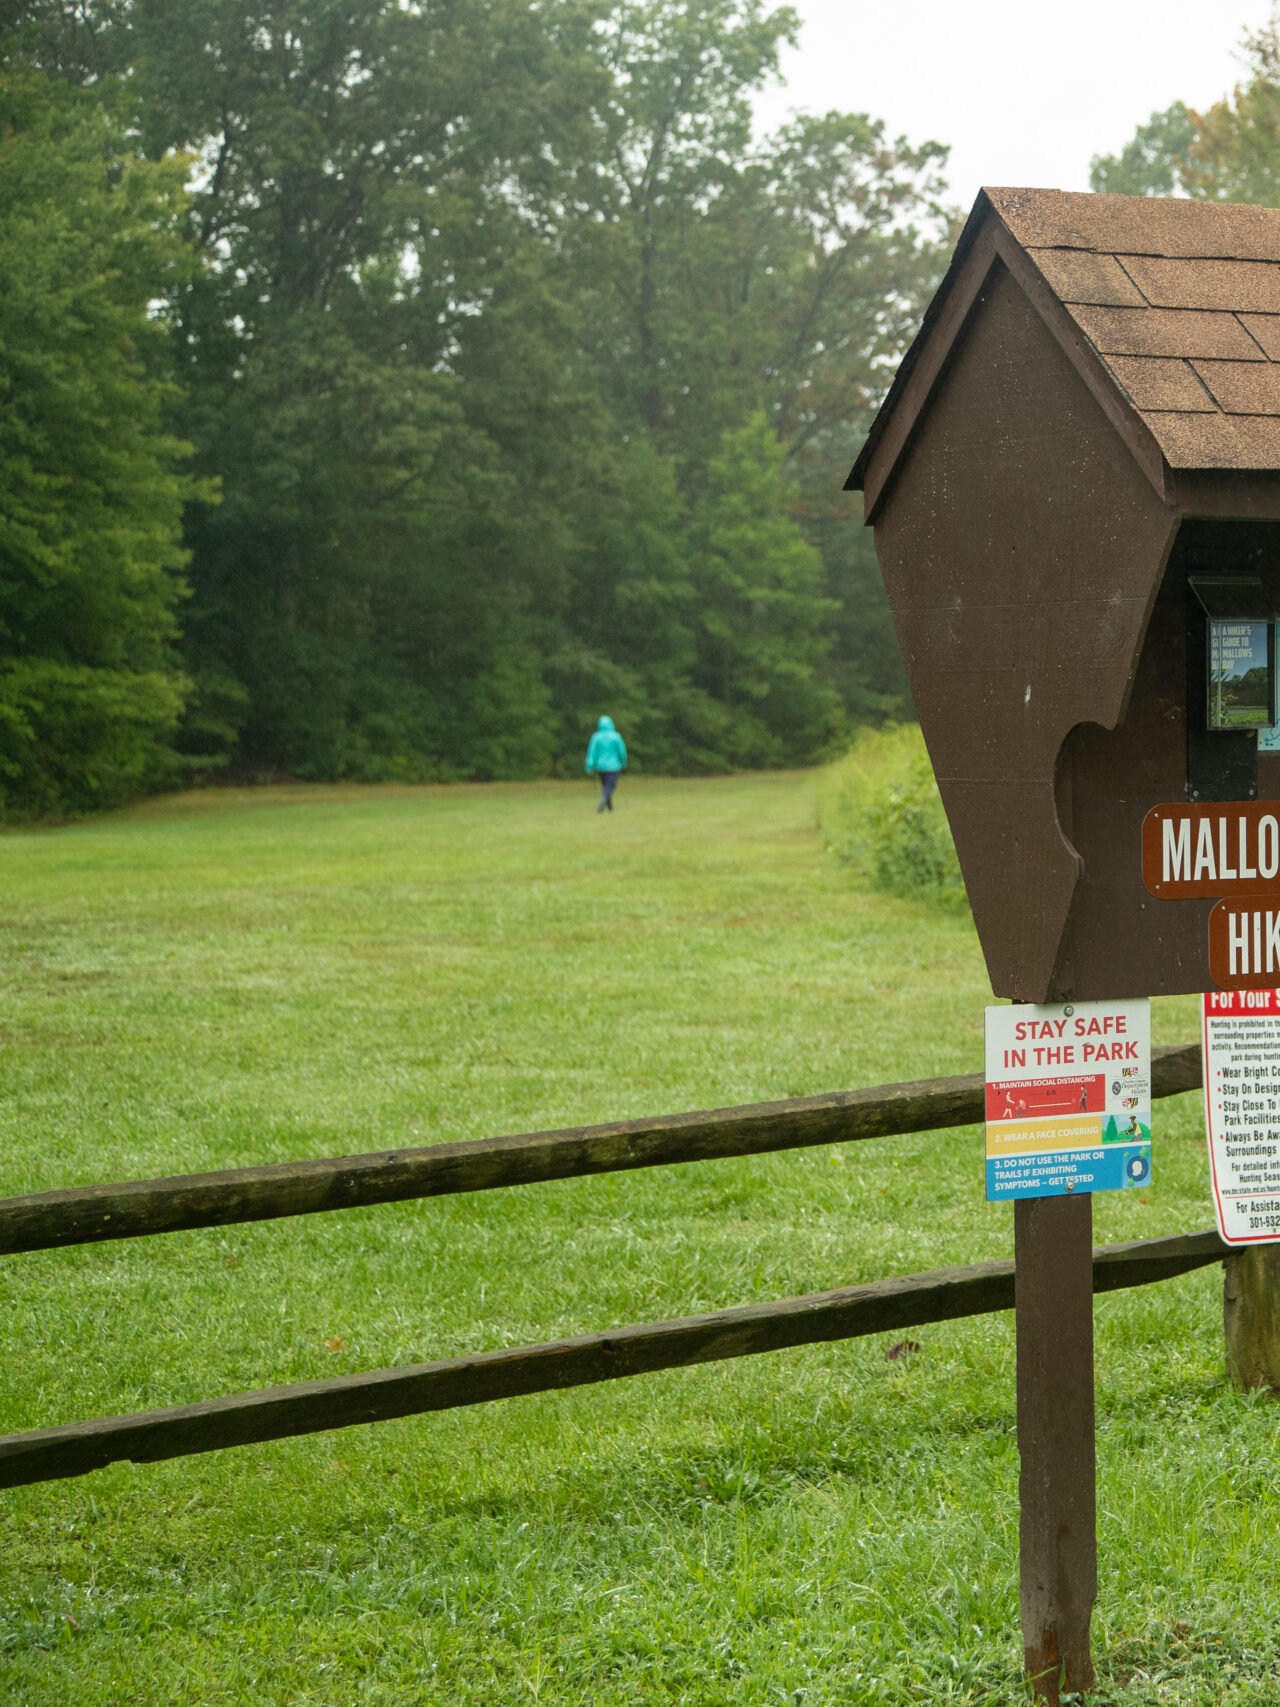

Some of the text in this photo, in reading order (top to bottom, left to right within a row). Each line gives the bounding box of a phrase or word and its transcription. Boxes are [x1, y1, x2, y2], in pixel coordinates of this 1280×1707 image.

[1222, 637, 1249, 647] GUIDE TO
[1222, 648, 1252, 658] MALLOWS
[1222, 660, 1235, 669] BAY
[1211, 992, 1234, 1008] For
[1238, 990, 1271, 1008] Your
[1015, 1016, 1127, 1041] STAY SAFE
[1211, 1021, 1231, 1029] Hunting
[1233, 1020, 1237, 1028] is
[1238, 1020, 1265, 1029] prohibited
[1268, 1020, 1273, 1028] in
[1214, 1032, 1244, 1040] surrounding
[1246, 1032, 1274, 1040] properties
[1004, 1040, 1139, 1068] IN THE PARK
[1244, 1054, 1262, 1062] during
[1222, 1067, 1241, 1078] Wear
[1244, 1066, 1268, 1079] Bright
[999, 1080, 1032, 1089] MAINTAIN
[1032, 1078, 1056, 1087] SOCIAL
[1057, 1075, 1096, 1085] DISTANCING
[1222, 1084, 1239, 1096] Stay
[1242, 1083, 1251, 1094] On
[1224, 1101, 1240, 1113] Stay
[1243, 1100, 1264, 1111] Close
[1267, 1099, 1276, 1109] To
[1224, 1115, 1241, 1126] Park
[1004, 1133, 1028, 1142] WEAR
[1029, 1132, 1035, 1140] A
[1036, 1130, 1056, 1139] FACE
[1058, 1126, 1099, 1137] COVERING
[1225, 1132, 1251, 1144] Always
[1254, 1130, 1264, 1141] Be
[1226, 1145, 1277, 1157] Surroundings
[995, 1151, 1104, 1169] 3. DO NOT USE THE PARK OR
[1232, 1163, 1240, 1172] For
[1243, 1161, 1267, 1171] detailed
[995, 1165, 1077, 1180] TRAILS IF EXHIBITING
[1239, 1173, 1262, 1183] Hunting
[994, 1179, 1040, 1191] SYMPTOMS
[1049, 1177, 1063, 1186] GET
[1065, 1174, 1094, 1183] TESTED
[1236, 1202, 1247, 1214] For
